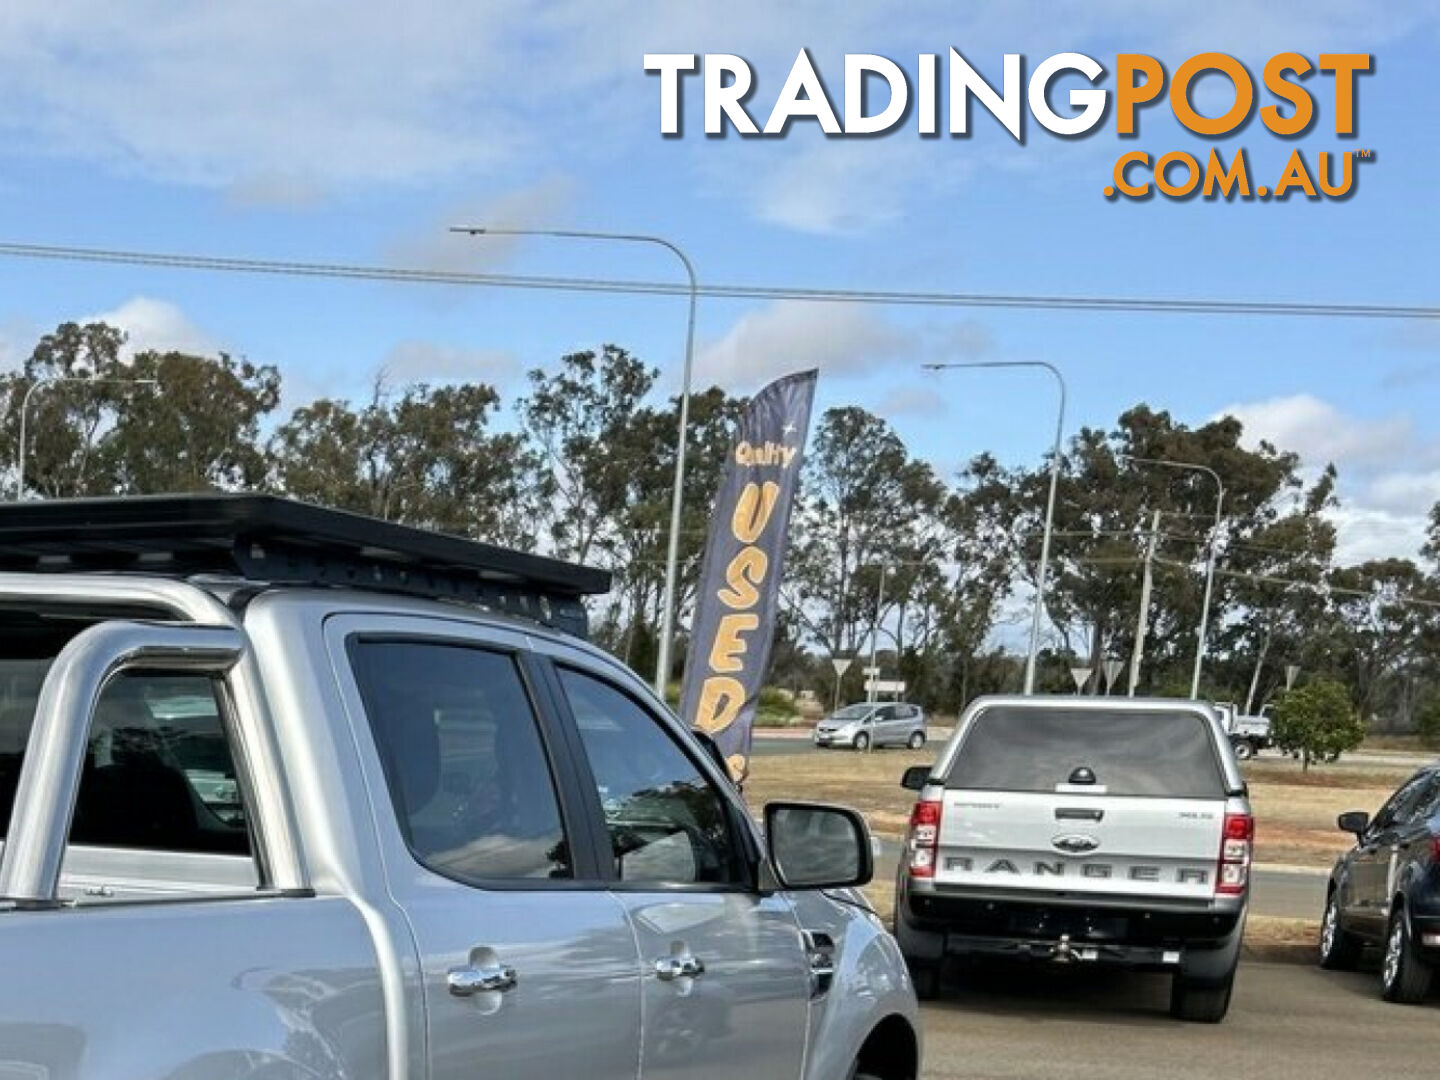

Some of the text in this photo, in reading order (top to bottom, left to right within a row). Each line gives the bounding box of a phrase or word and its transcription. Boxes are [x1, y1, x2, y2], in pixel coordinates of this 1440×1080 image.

[734, 440, 798, 469] Quality
[694, 481, 781, 735] USED
[944, 856, 1210, 885] RANGER
